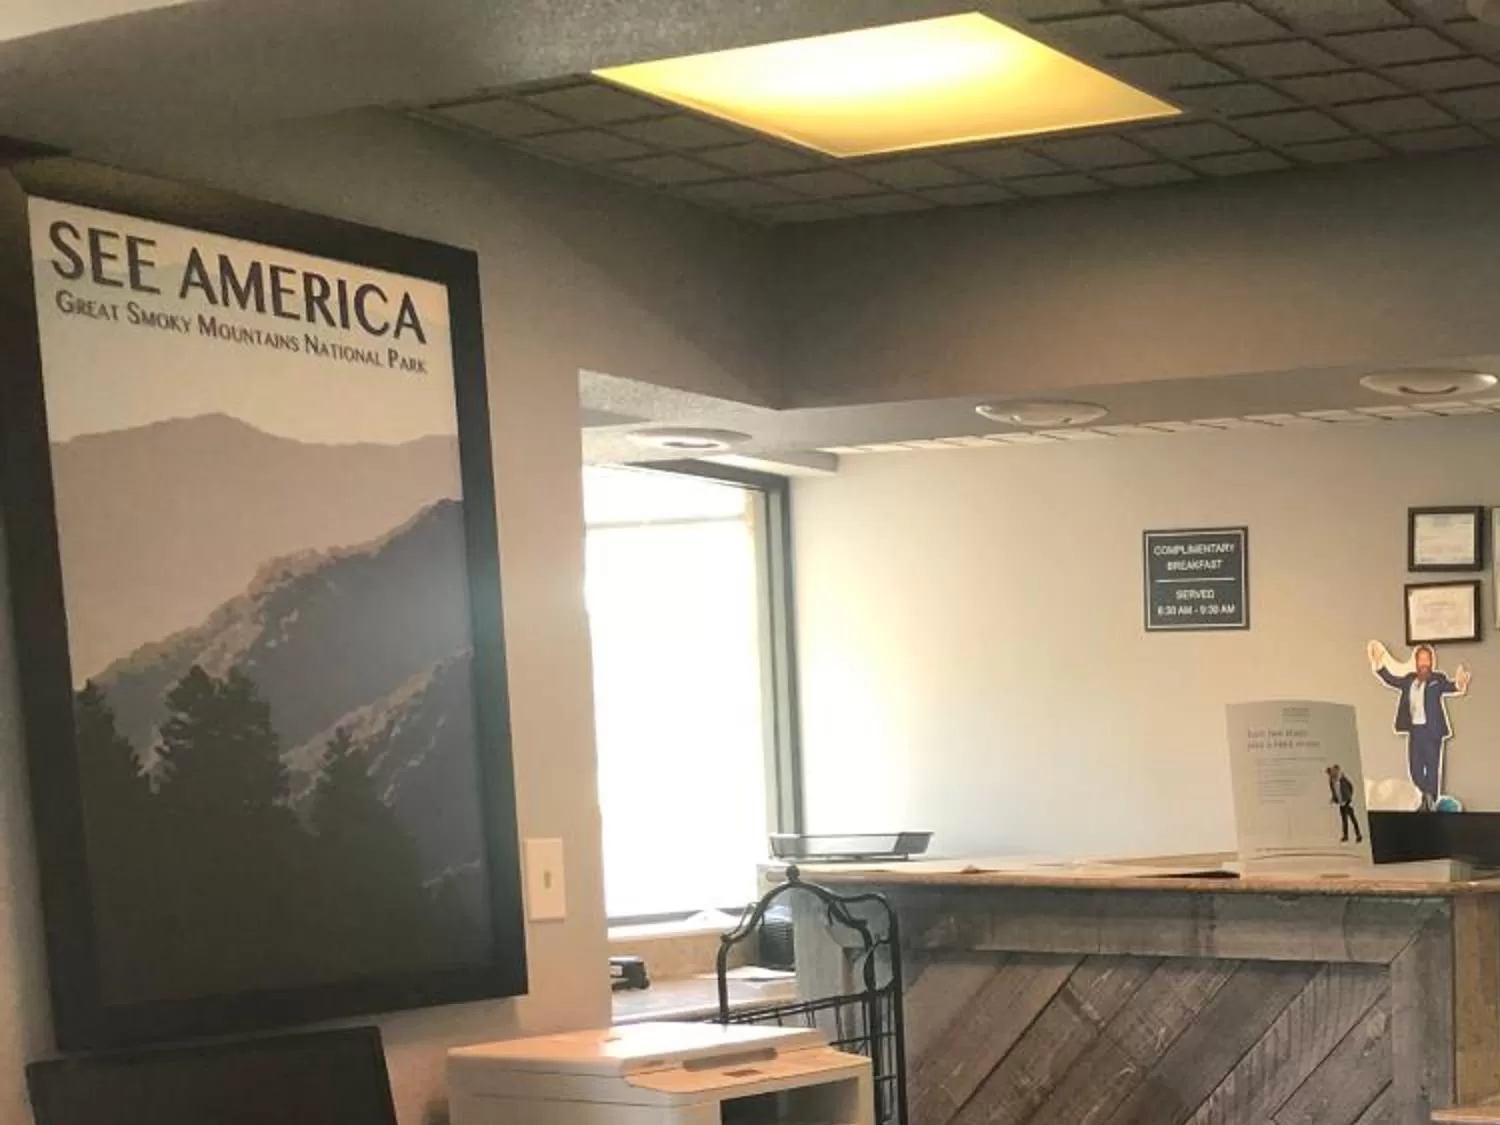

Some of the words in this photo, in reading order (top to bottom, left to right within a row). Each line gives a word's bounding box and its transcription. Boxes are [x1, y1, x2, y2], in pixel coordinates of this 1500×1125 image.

[49, 219, 161, 295] SEE
[179, 246, 427, 345] AMERICA
[1153, 543, 1236, 556] COMPLIMENTARY
[1167, 559, 1223, 571] BREAKFAST
[1175, 589, 1215, 600] SERVED
